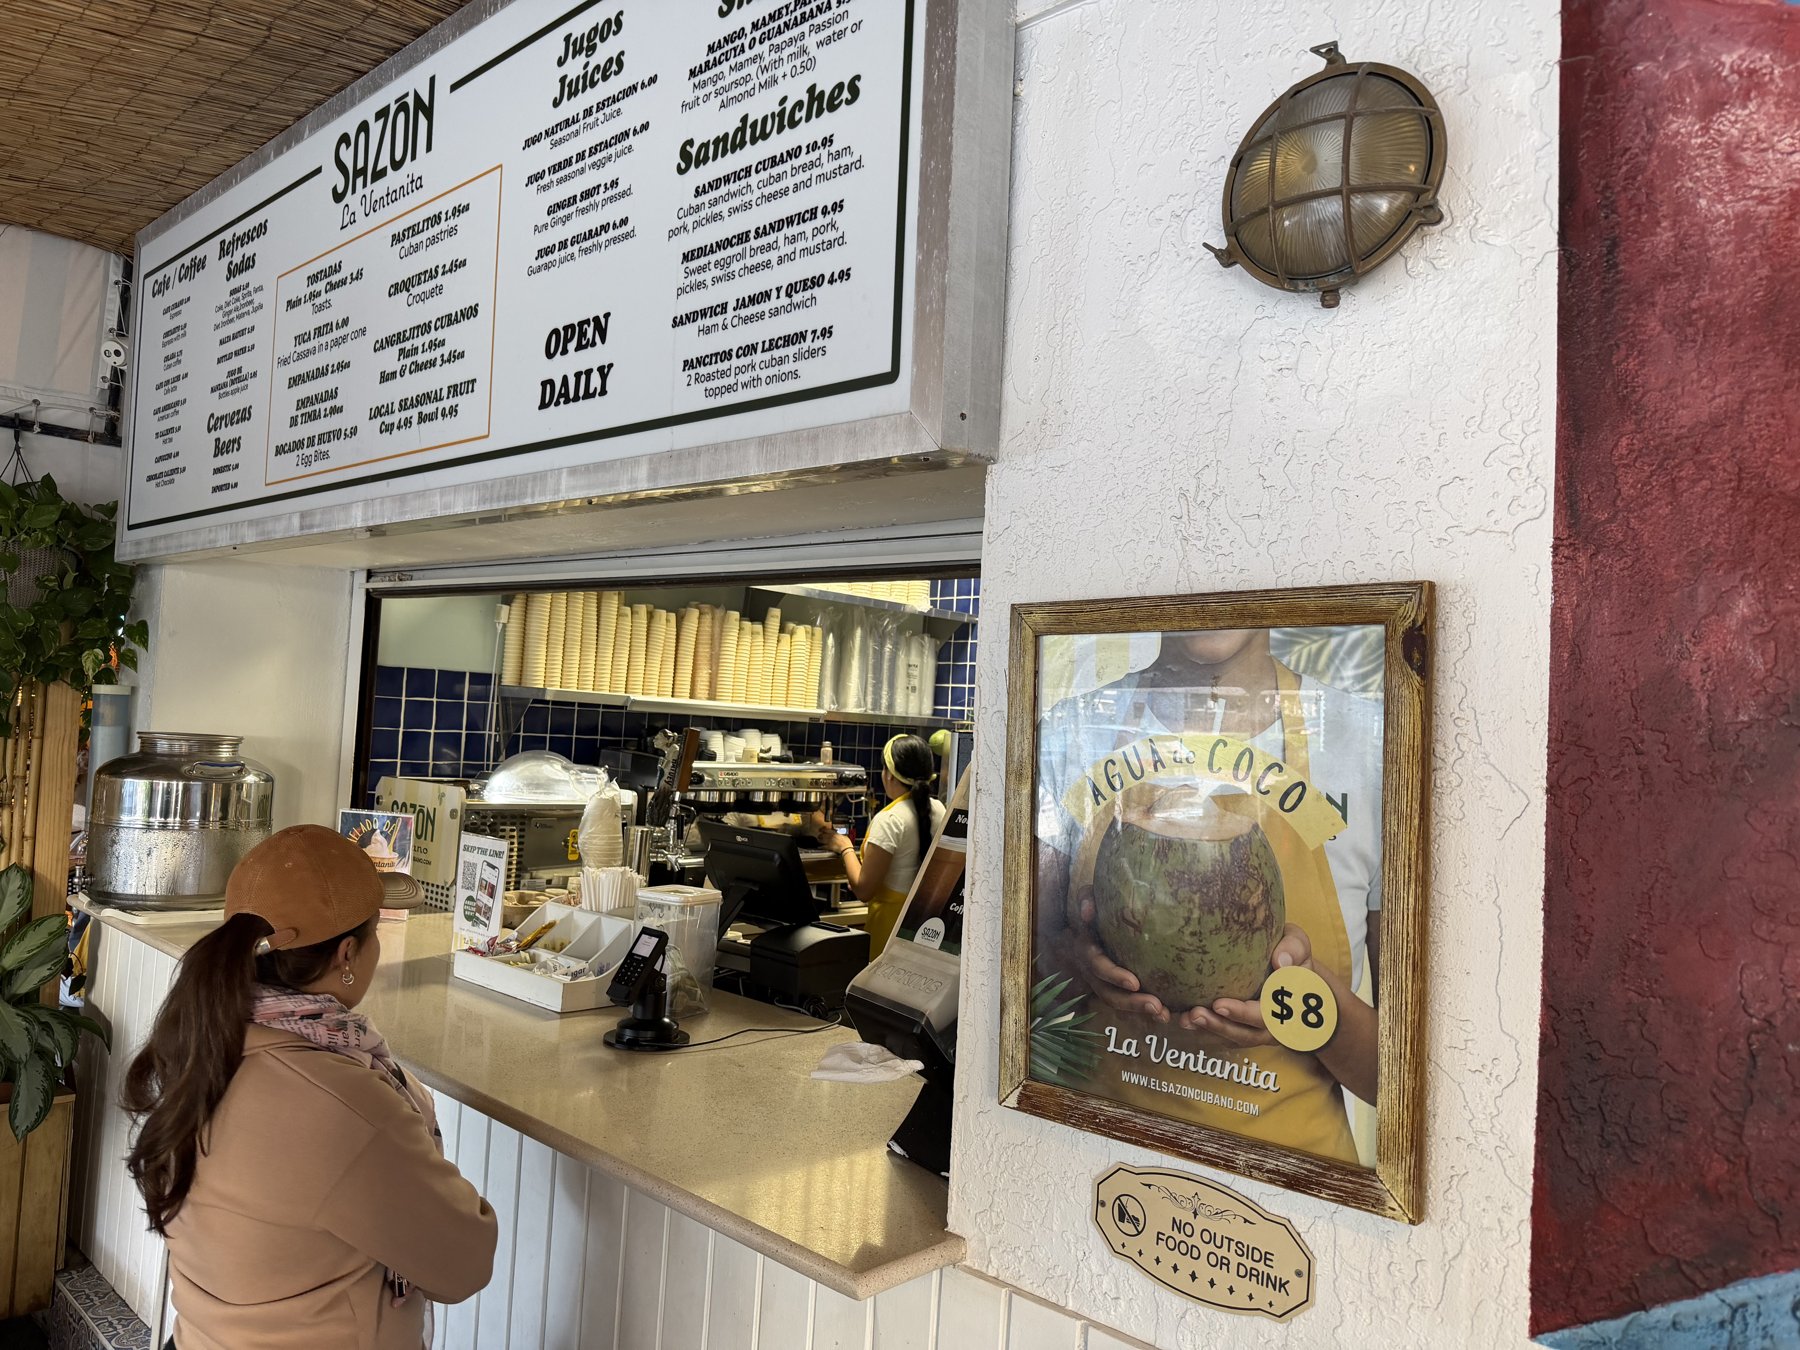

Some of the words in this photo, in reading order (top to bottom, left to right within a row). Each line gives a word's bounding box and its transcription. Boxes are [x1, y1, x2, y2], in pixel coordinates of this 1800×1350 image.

[556, 9, 625, 67] Jugos
[687, 45, 746, 81] MARACUYA
[748, 37, 757, 51] O
[758, 0, 832, 45] GUANABANA
[552, 50, 625, 108] Juices
[522, 131, 542, 150] JUGO
[543, 112, 580, 140] NATURAL
[582, 104, 594, 120] DE
[594, 81, 638, 114] ESTACION
[640, 73, 657, 90] 6.00
[550, 124, 580, 149] Seasonal
[582, 116, 599, 133] Fruit
[600, 107, 622, 124] Juice.
[676, 74, 861, 175] Sandwiches
[525, 168, 546, 187] JUGO
[547, 155, 573, 176] VERDE
[574, 149, 586, 164] DE
[587, 128, 630, 158] ESTACION
[632, 120, 649, 136] 6.00
[536, 178, 554, 194] Fresh
[555, 162, 586, 186] seasonal
[588, 152, 612, 170] veggie
[613, 144, 634, 162] juice.
[694, 164, 753, 198] SANDWICH
[754, 144, 802, 174] CUBANO
[805, 133, 834, 155] 10.95
[340, 203, 357, 230] La
[357, 172, 423, 219] Ventanita
[533, 222, 548, 235] Pure
[550, 211, 573, 228] Ginger
[575, 199, 600, 217] freshly
[601, 184, 632, 210] pressed.
[546, 194, 577, 216] GINGER
[578, 183, 601, 202] SHOT
[602, 177, 619, 193] 3.95
[217, 218, 268, 261] Refrescos
[390, 210, 442, 247] PASTELITOS
[444, 202, 470, 222] 1.95ea
[398, 240, 423, 259] Cuban
[425, 224, 457, 251] pastries
[535, 243, 556, 260] JUGO
[557, 238, 568, 252] DE
[569, 221, 610, 247] GUARAPO
[611, 216, 628, 230] 6.00
[681, 229, 751, 264] MEDIANOCHE
[752, 205, 818, 240] SANDWICH
[820, 198, 844, 218] 9.95
[151, 273, 170, 298] Cafe
[171, 267, 177, 289] /
[178, 254, 206, 283] Coffee
[225, 252, 256, 282] Sodas
[306, 260, 342, 288] TOSTADAS
[388, 264, 439, 297] CROQUETAS
[440, 258, 466, 276] 2.45ea
[285, 295, 302, 312] Plain
[303, 289, 321, 304] 1.95ea
[324, 276, 347, 294] Cheese
[348, 267, 363, 284] 3.45
[311, 298, 332, 314] Toasts.
[406, 283, 443, 306] Croquete
[671, 301, 728, 328] SANDWICH
[732, 288, 773, 311] JAMON
[775, 285, 783, 300] Y
[784, 273, 825, 298] QUESO
[827, 266, 851, 285] 4.95
[276, 352, 291, 368] Fried
[292, 345, 316, 362] Cassava
[317, 340, 323, 353] in
[324, 341, 328, 350] a
[329, 332, 349, 351] paper
[350, 326, 366, 340] cone
[294, 330, 311, 347] YUCA
[312, 320, 333, 340] FRITA
[335, 316, 349, 330] 6.00
[373, 320, 432, 353] CANGREJITOS
[433, 302, 478, 332] CUBANOS
[544, 311, 611, 359] OPEN
[682, 348, 733, 372] PANCITOS
[734, 341, 759, 359] CON
[760, 329, 808, 353] LECHON
[809, 325, 833, 343] 7.95
[379, 369, 397, 384] Ham
[398, 363, 407, 377] &
[408, 356, 437, 375] Cheese
[439, 348, 464, 367] 3.45ea
[397, 343, 418, 362] Plain
[421, 337, 445, 354] 1.95ea
[287, 363, 329, 389] EMPANADAS
[330, 360, 350, 374] 2.95ea
[537, 362, 613, 410] DAILY
[206, 404, 252, 433] Cervezas
[289, 414, 298, 428] DE
[300, 407, 321, 425] TIMBA
[322, 404, 343, 418] 2.90ea
[295, 386, 338, 411] EMPANADAS
[368, 401, 395, 420] LOCAL
[397, 387, 444, 412] SEASONAL
[446, 378, 476, 400] FRUIT
[379, 420, 394, 435] Cup
[396, 415, 413, 431] 4.95
[416, 406, 438, 425] Bowl
[440, 403, 458, 420] 9.95
[212, 435, 241, 458] Beers
[274, 437, 305, 456] BOCADOS
[305, 434, 316, 448] DE
[316, 427, 342, 446] HUEVO
[343, 425, 357, 440] 5.50
[296, 454, 299, 466] 2
[300, 453, 312, 467] Egg
[314, 448, 330, 462] Bites.
[1086, 738, 1166, 806] AGUA
[1208, 738, 1307, 813] COCO
[346, 817, 379, 843] ELADO
[462, 844, 477, 854] SKIP
[476, 846, 489, 856] THE
[488, 848, 505, 860] LINE!
[870, 961, 943, 994] NAPKINS
[1271, 986, 1325, 1029] $8
[1104, 1026, 1140, 1058] La
[1145, 1034, 1281, 1092] Ventanita
[1121, 1070, 1260, 1116] WWW.ELSAZONCUBANO.COM
[1156, 1231, 1201, 1262] FOOD
[1206, 1251, 1231, 1274] OR
[1236, 1262, 1291, 1297] DRINK
[1171, 1216, 1195, 1239] NO
[1200, 1228, 1275, 1269] OUTSIDE
